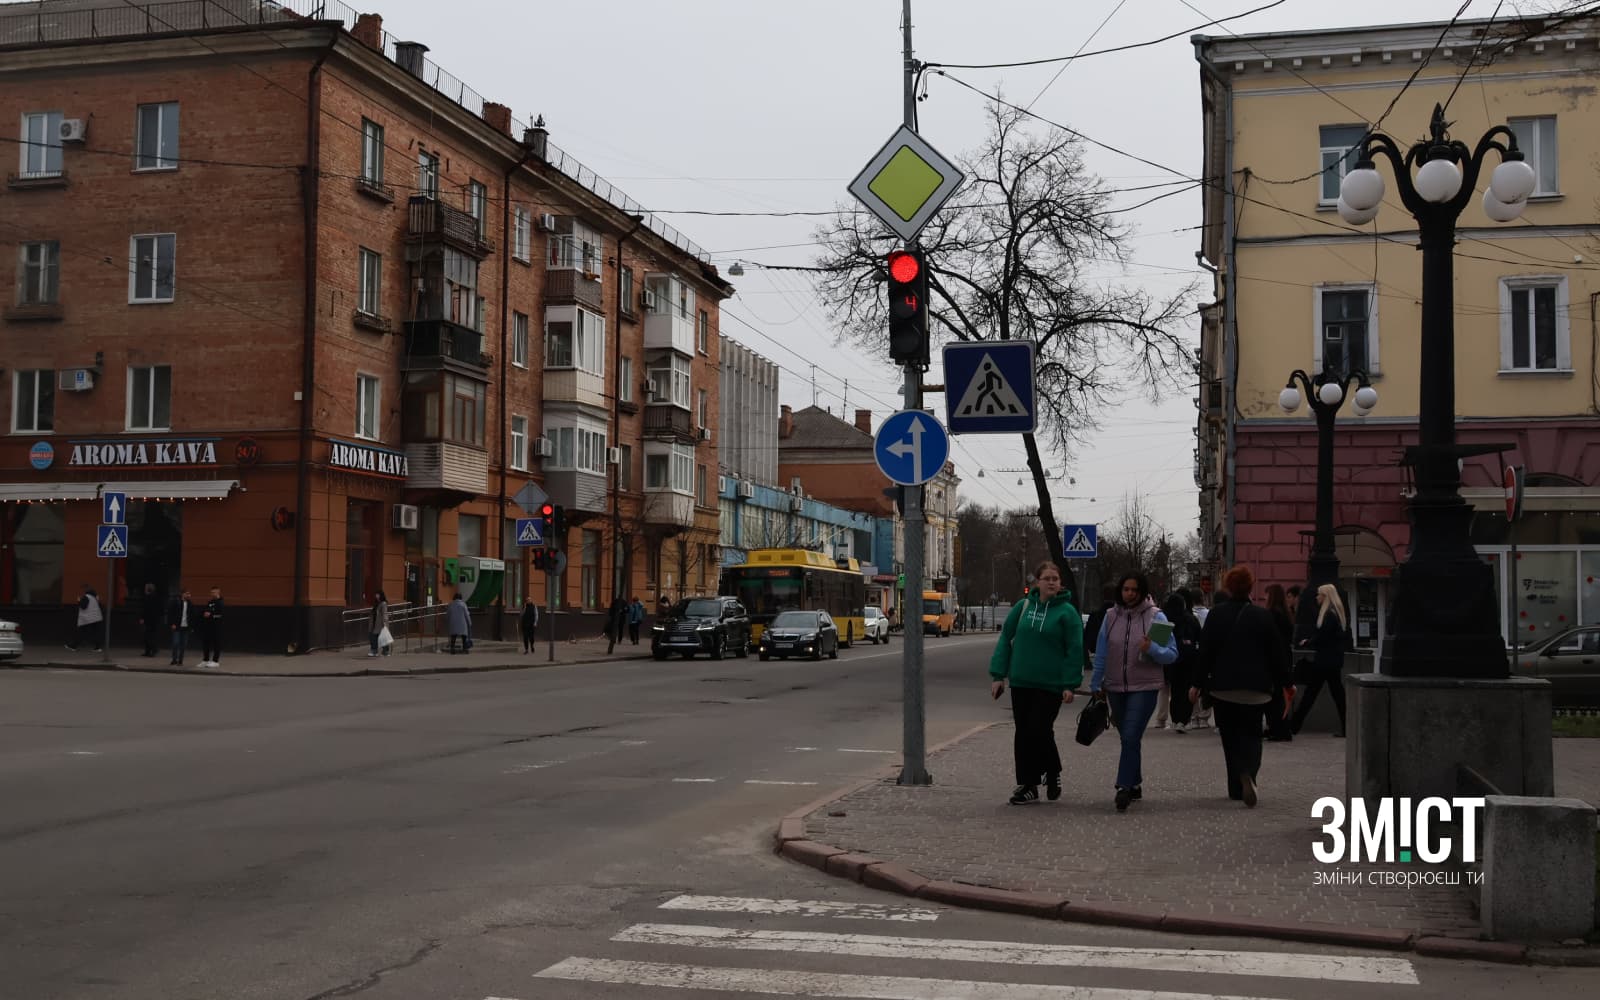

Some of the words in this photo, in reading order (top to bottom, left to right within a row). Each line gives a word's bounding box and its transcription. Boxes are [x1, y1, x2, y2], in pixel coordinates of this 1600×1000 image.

[905, 295, 917, 311] 4
[69, 443, 148, 466] AROMA
[155, 441, 217, 465] KAVA
[330, 443, 375, 471] AROMA
[378, 451, 409, 476] KAVA
